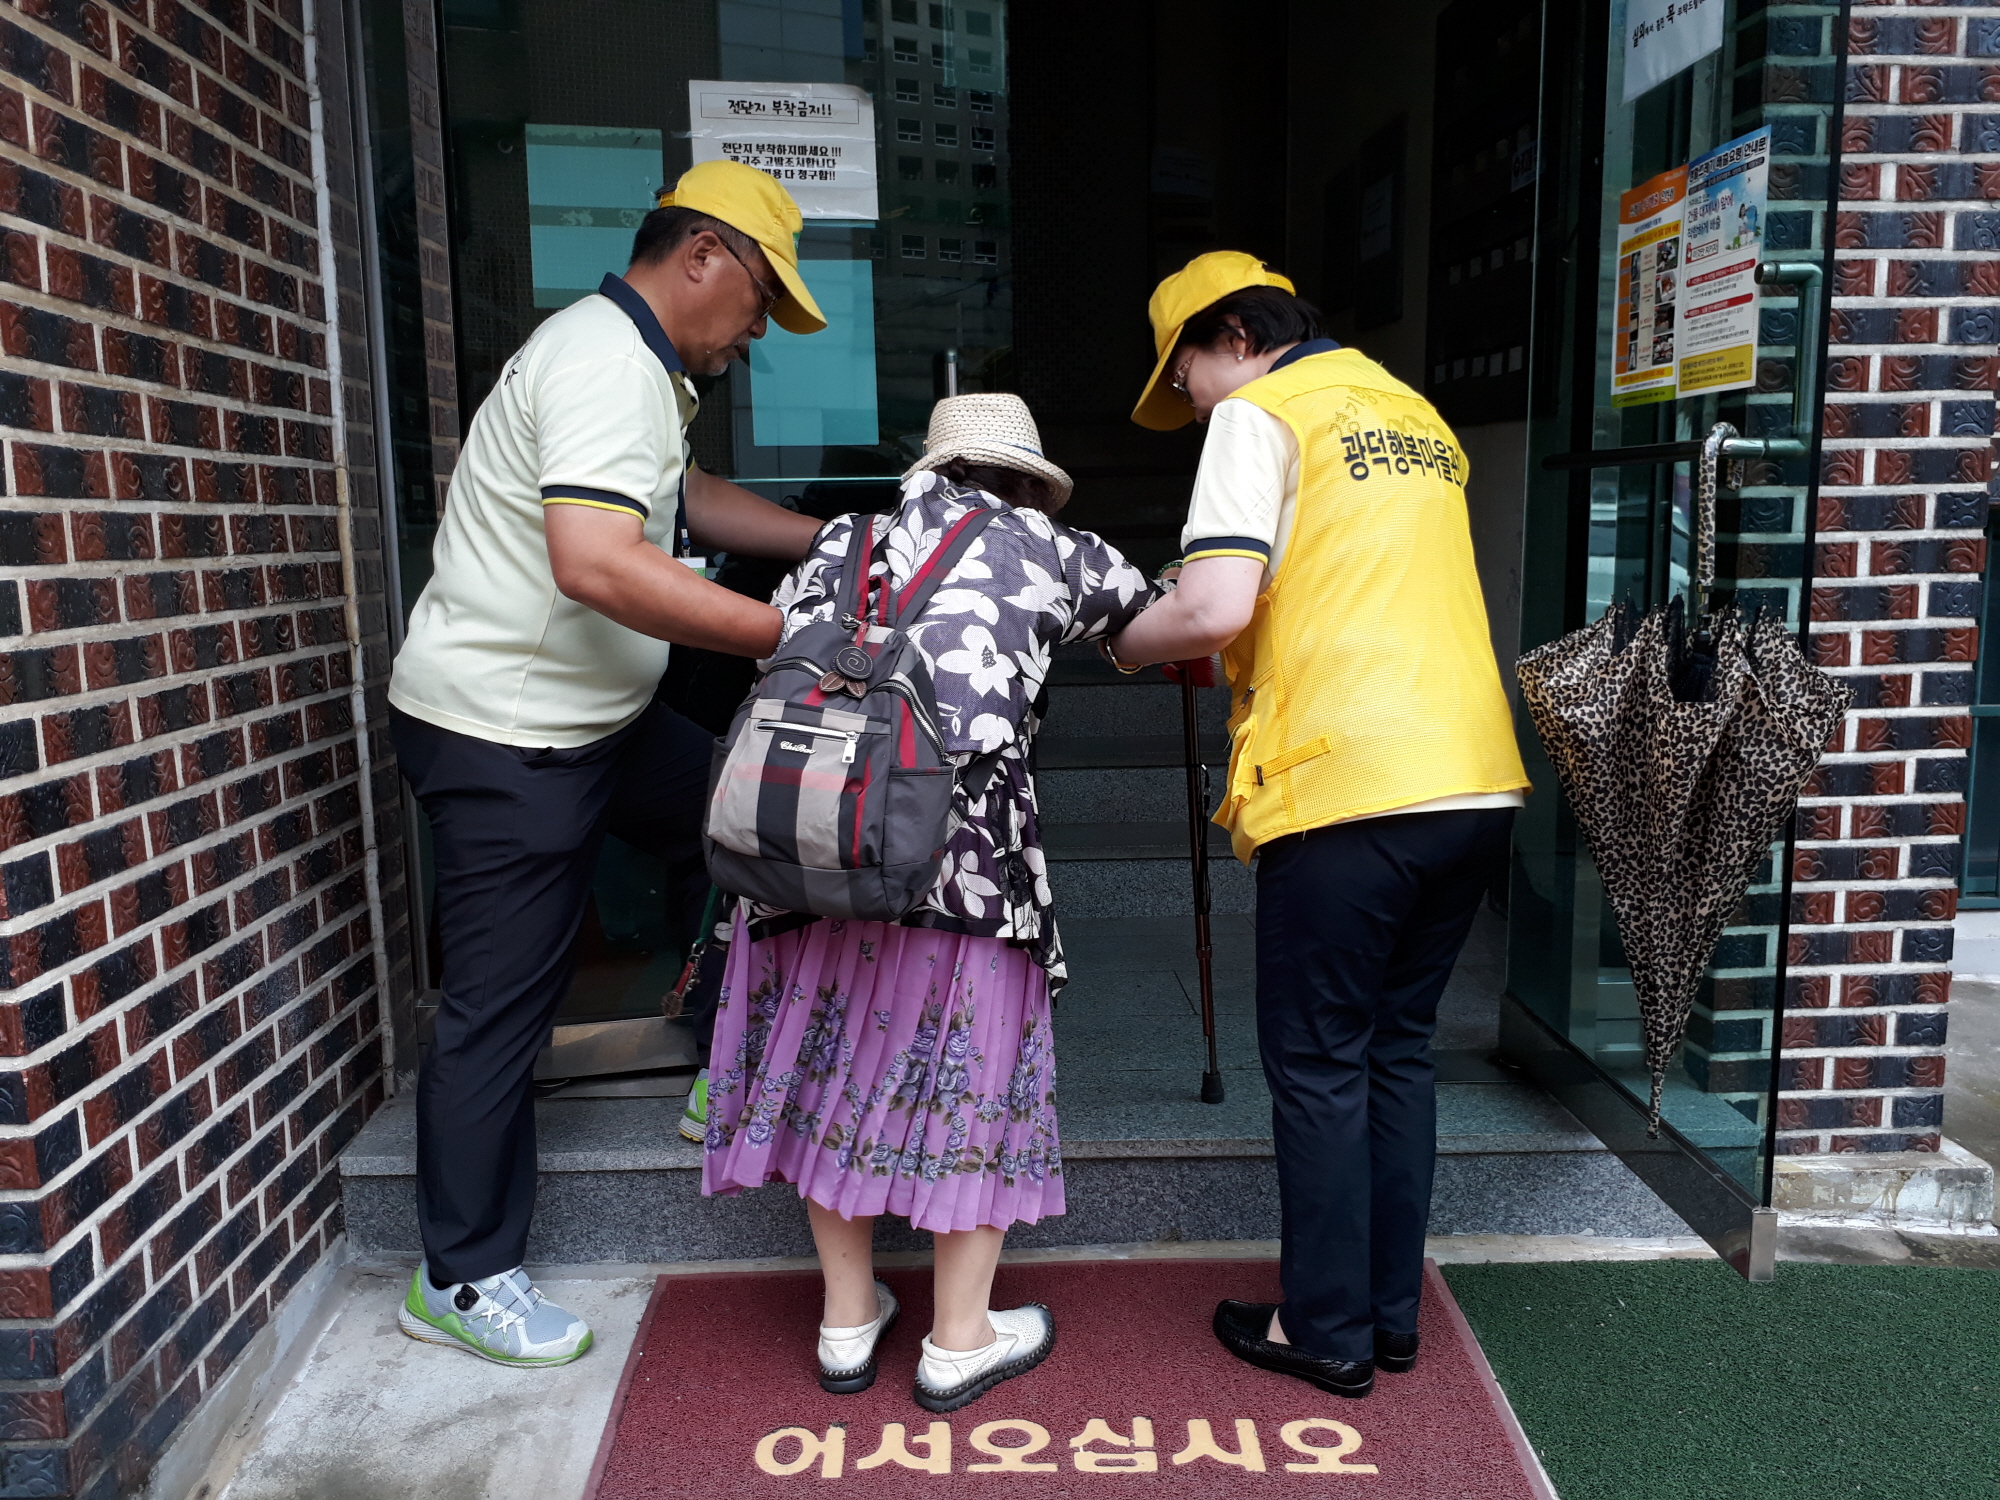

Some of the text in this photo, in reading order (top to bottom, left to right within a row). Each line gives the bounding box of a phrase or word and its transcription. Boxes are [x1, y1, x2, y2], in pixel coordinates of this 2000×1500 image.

[728, 99, 832, 117] 전단지 부착금지!!
[722, 142, 752, 154] 전단지
[756, 143, 829, 157] 부착하지마세요
[764, 156, 836, 169] 고발조치합니다
[785, 169, 795, 179] 다
[798, 169, 835, 181] 청구함!!
[754, 1416, 1379, 1478] 어서오십시오
